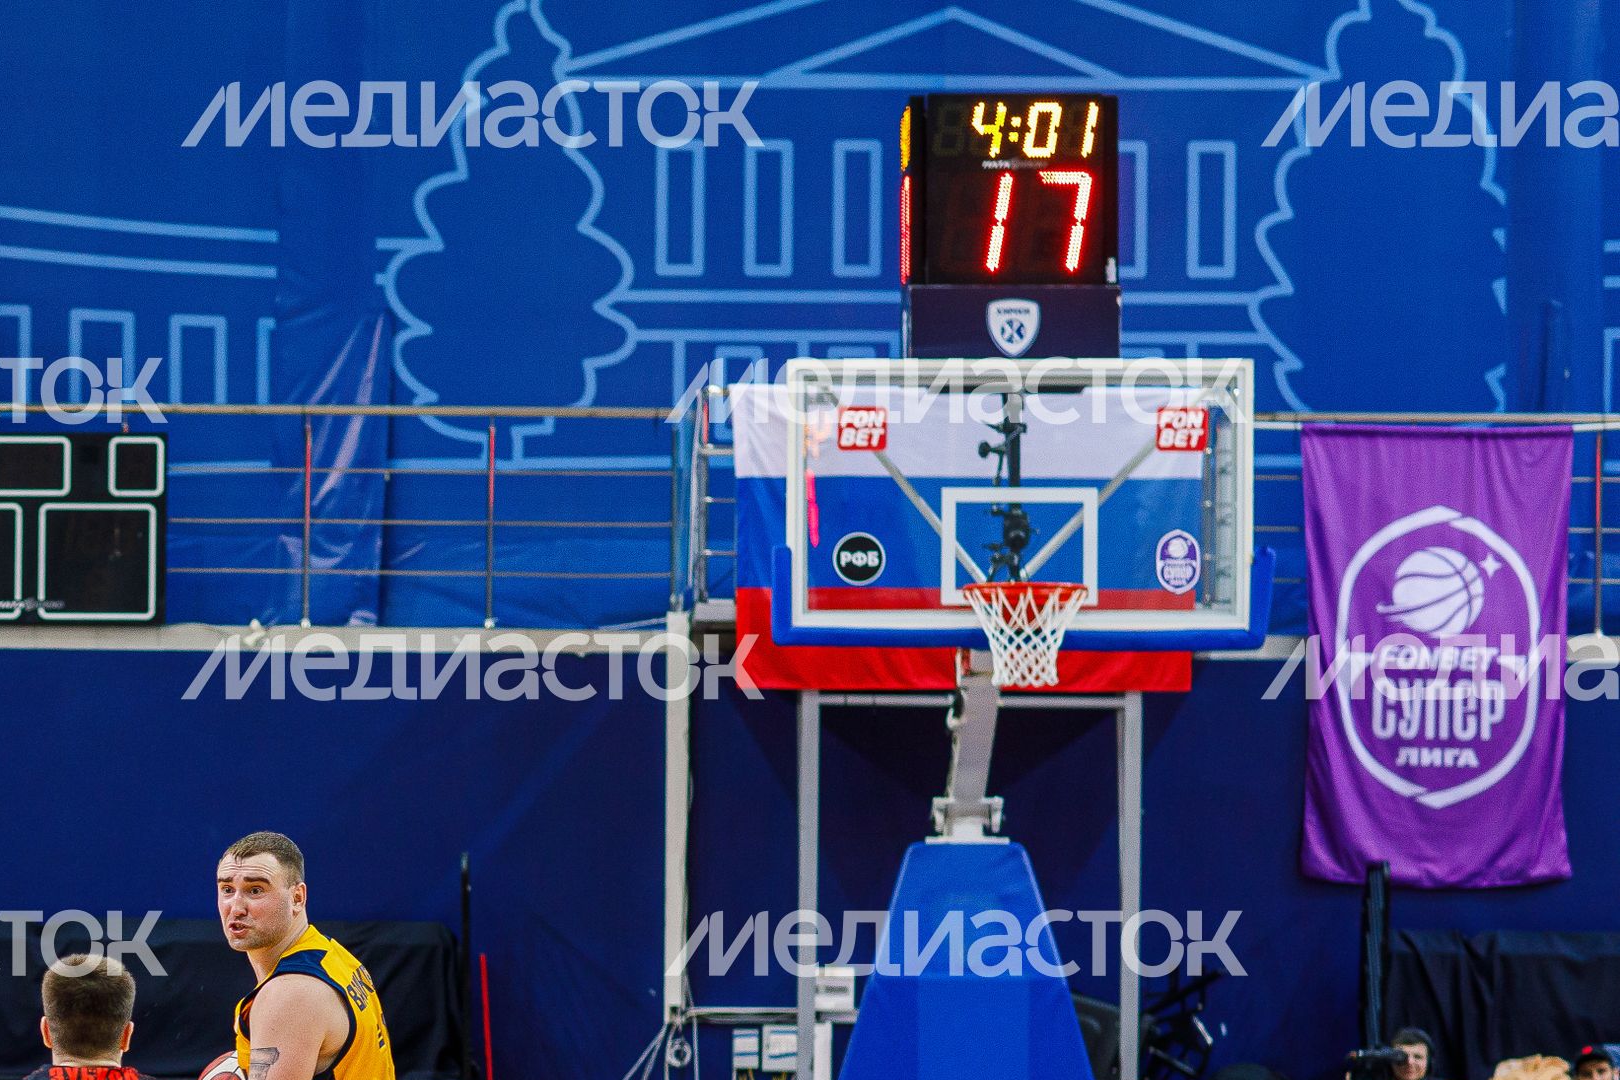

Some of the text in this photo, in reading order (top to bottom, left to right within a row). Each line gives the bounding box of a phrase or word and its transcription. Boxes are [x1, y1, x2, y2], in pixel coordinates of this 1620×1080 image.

[971, 102, 1099, 158] 4:01
[985, 171, 1093, 273] 17
[841, 410, 885, 427] FON
[1160, 410, 1203, 428] FON
[840, 428, 884, 447] BET
[1159, 428, 1203, 448] BET
[840, 550, 879, 568] РФБ
[1380, 645, 1499, 672] FONBET
[1396, 747, 1479, 767] ЛИГА
